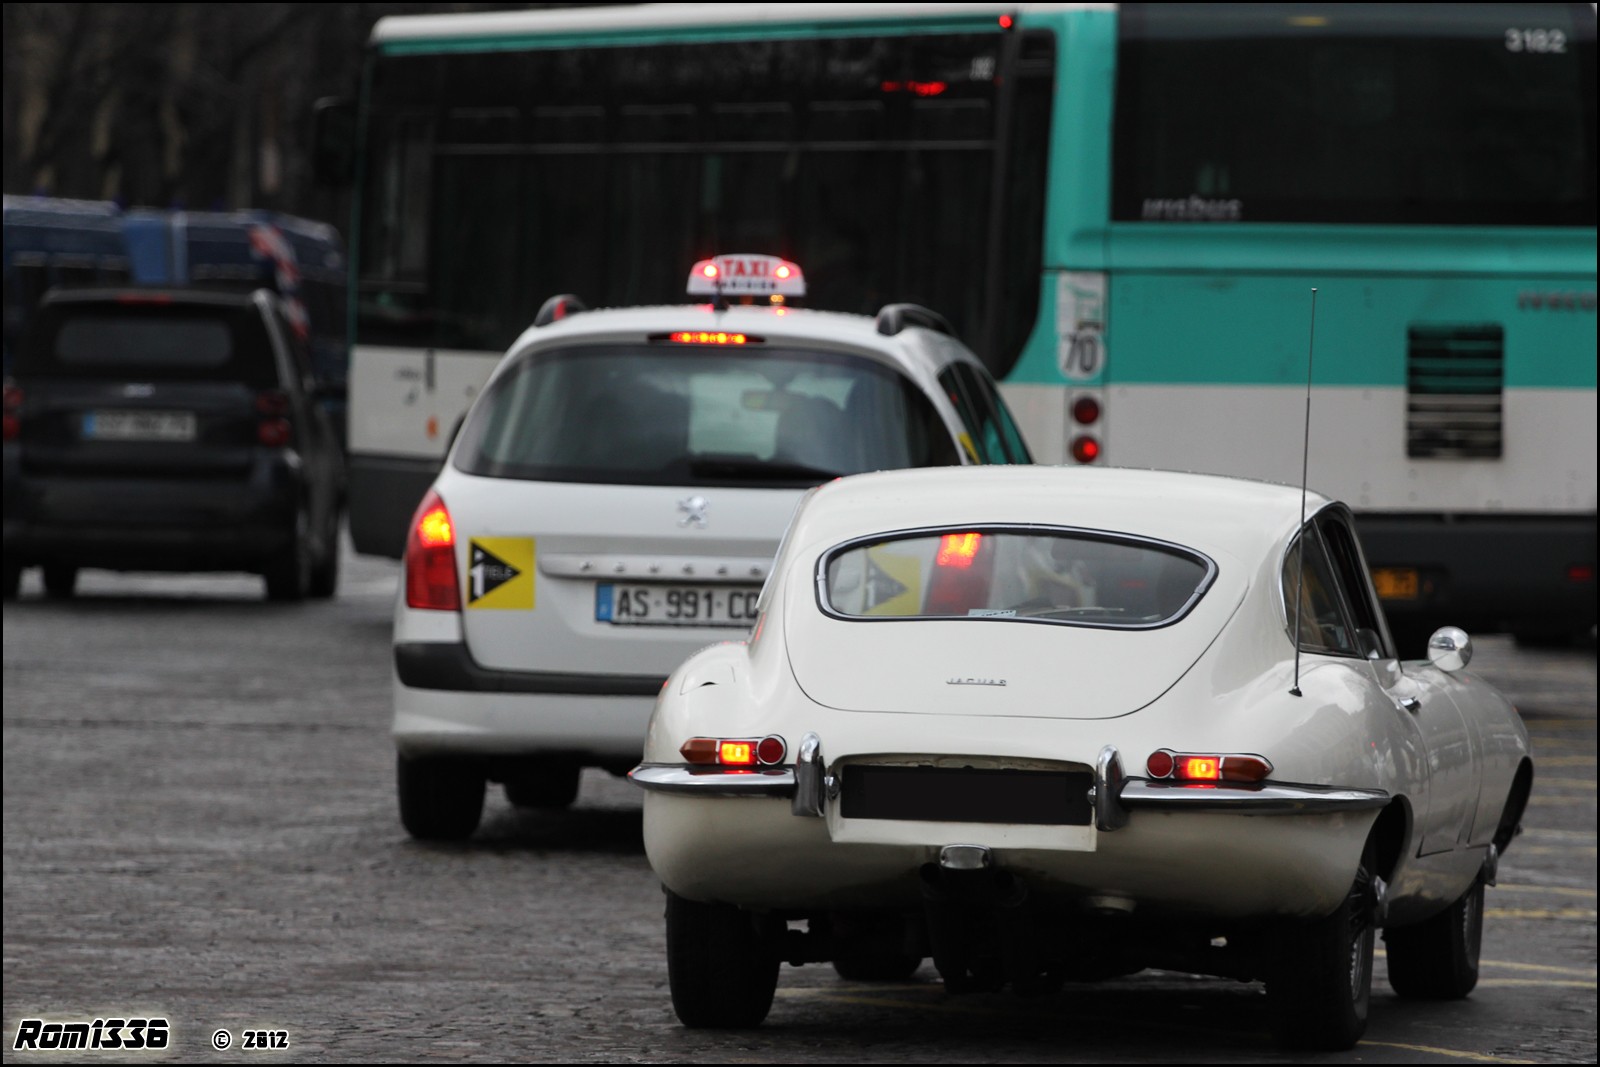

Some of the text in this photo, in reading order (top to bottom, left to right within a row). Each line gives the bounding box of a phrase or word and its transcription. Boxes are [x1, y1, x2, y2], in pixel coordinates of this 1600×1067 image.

[1504, 28, 1567, 52] 3182
[723, 259, 769, 277] TAXI
[1061, 333, 1098, 374] 70
